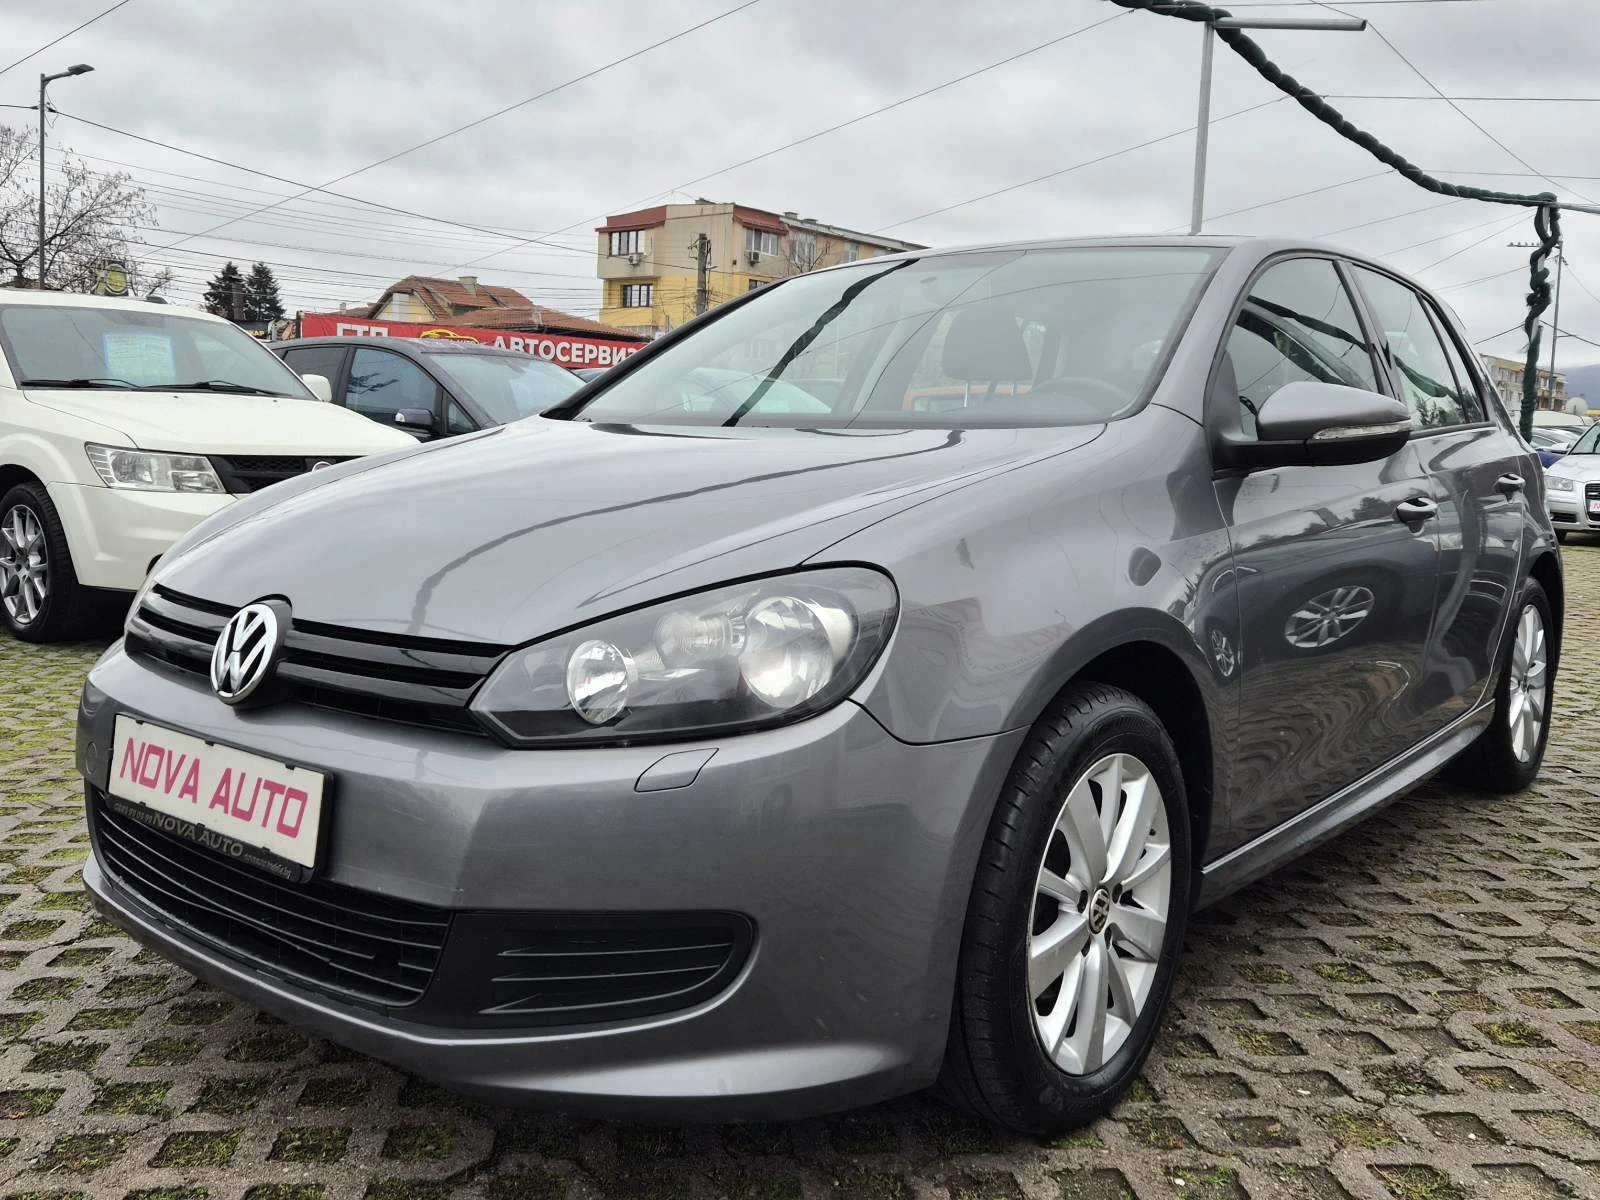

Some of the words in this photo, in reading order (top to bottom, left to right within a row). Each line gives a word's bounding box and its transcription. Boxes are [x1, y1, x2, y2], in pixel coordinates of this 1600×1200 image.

[119, 737, 201, 804] NOVA
[208, 767, 309, 839] AUTO
[152, 812, 196, 841] NOVA
[198, 831, 244, 857] AUTO
